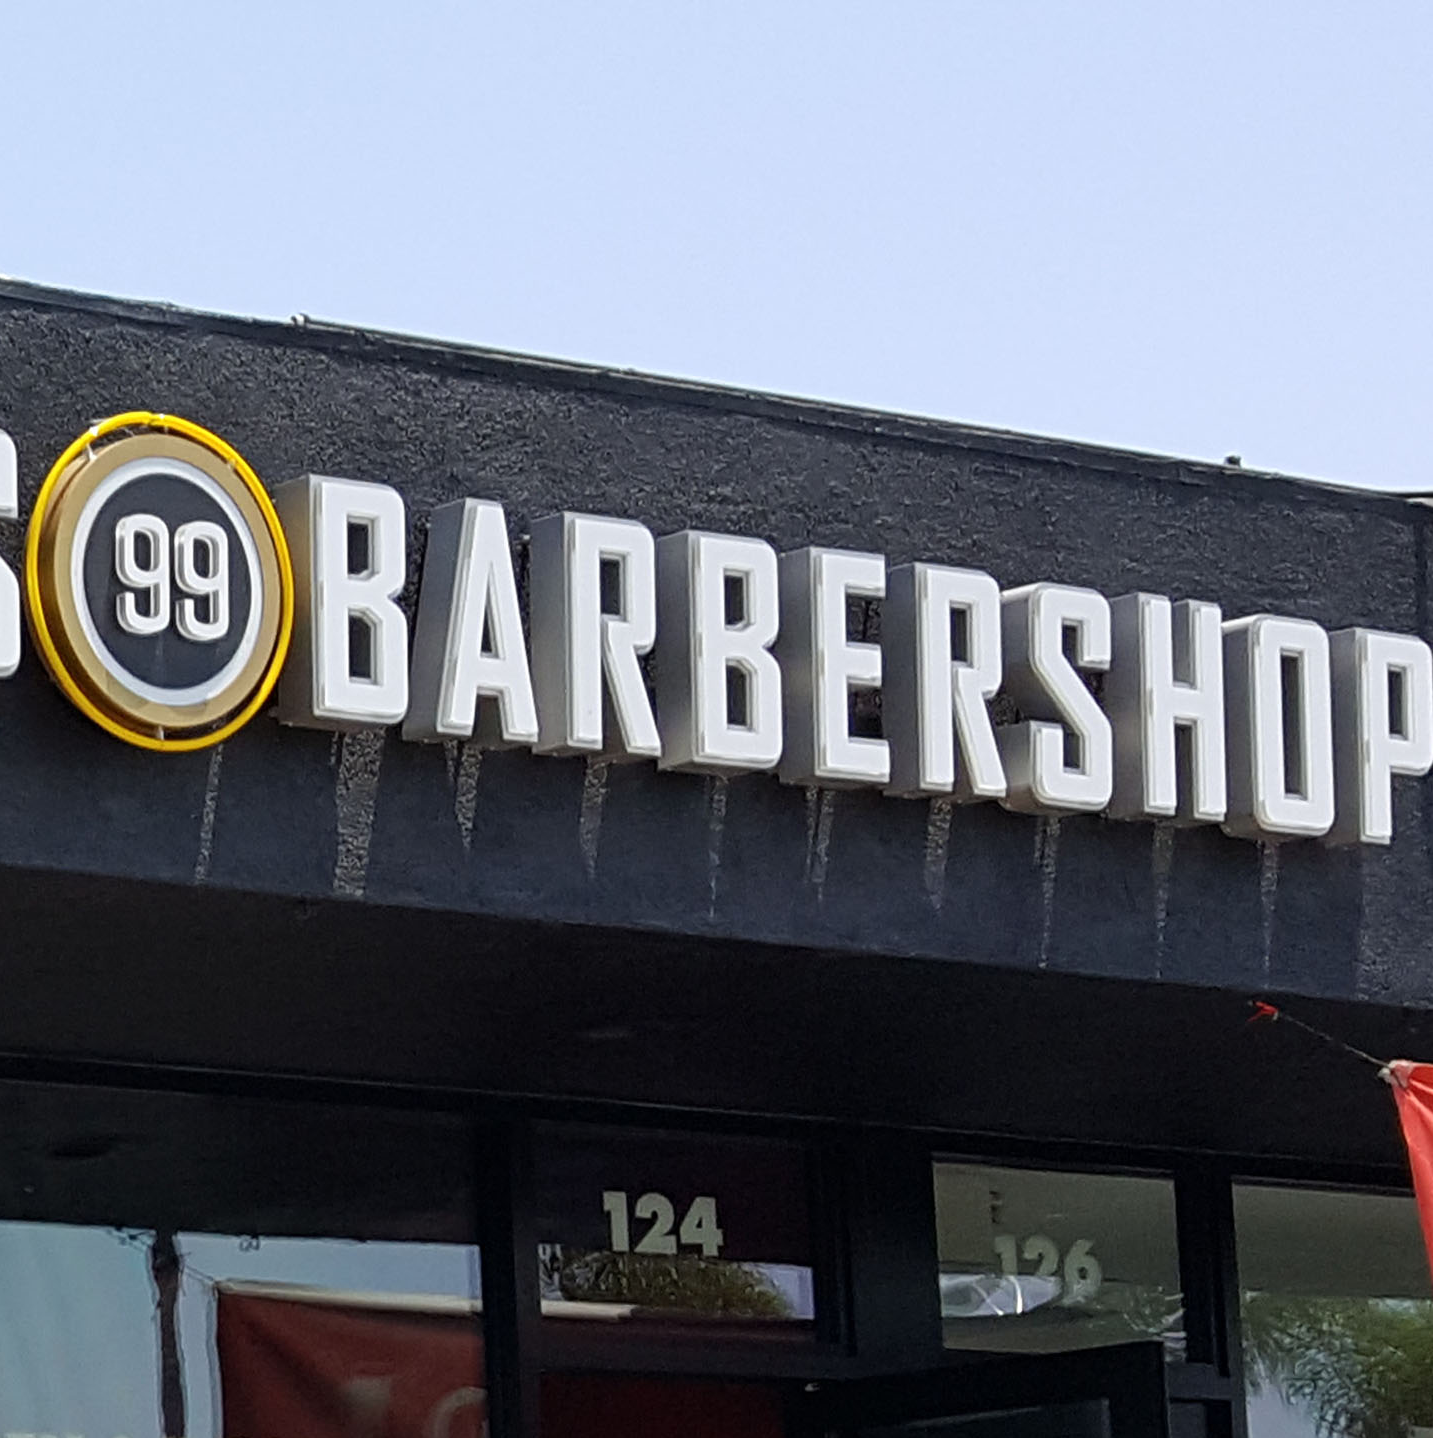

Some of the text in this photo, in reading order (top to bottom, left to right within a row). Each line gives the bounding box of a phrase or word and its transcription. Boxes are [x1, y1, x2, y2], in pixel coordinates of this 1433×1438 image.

[114, 514, 230, 642] 99
[298, 473, 1432, 845] BARBERSHOP
[603, 1191, 724, 1257] 124
[994, 1236, 1103, 1306] 126
